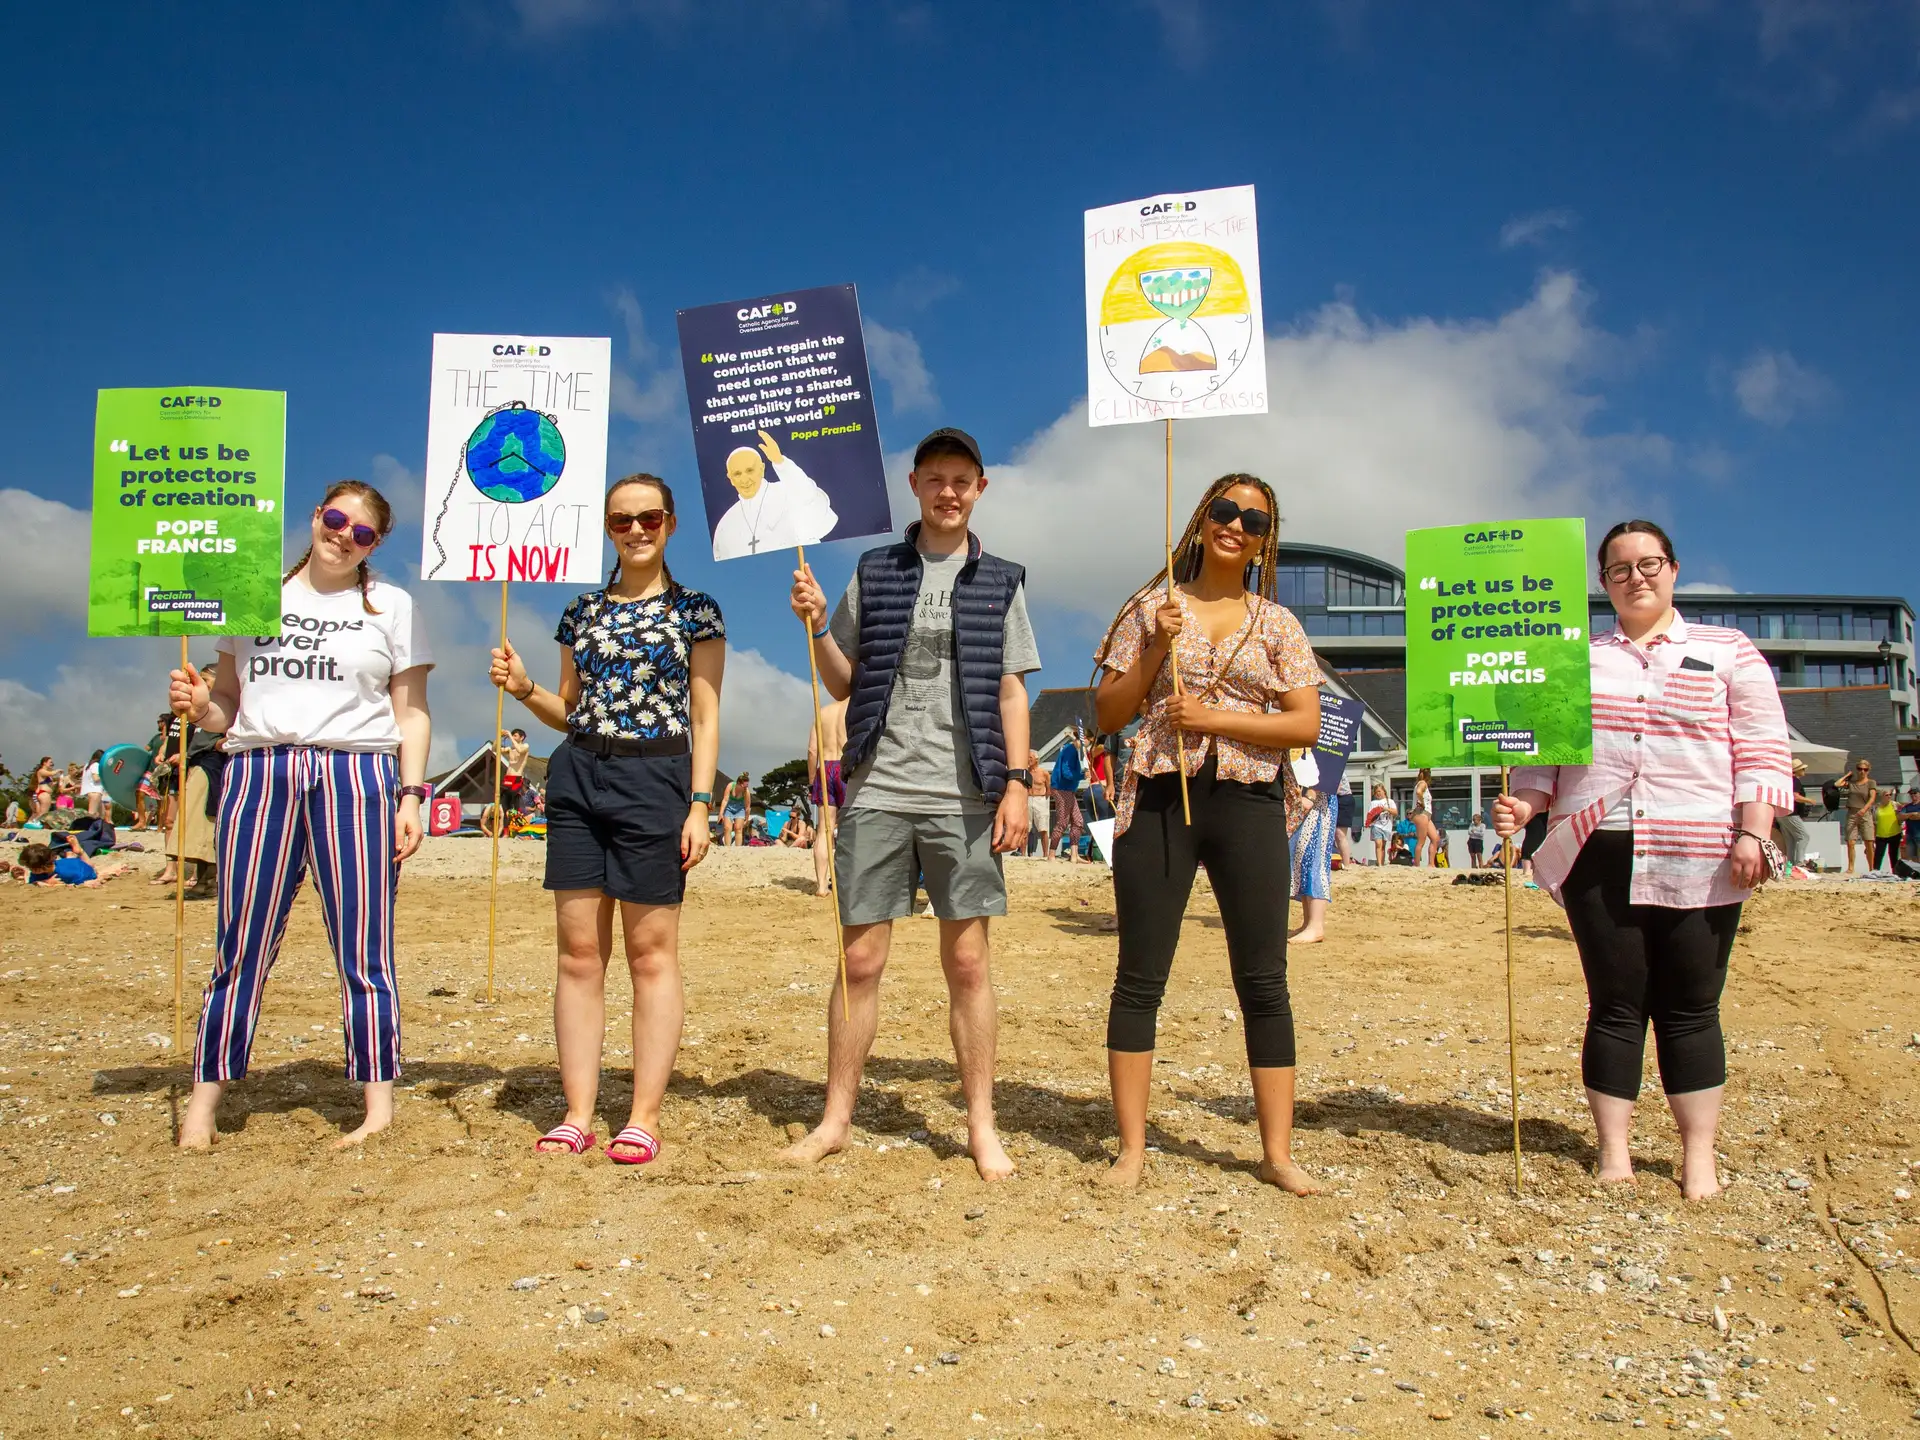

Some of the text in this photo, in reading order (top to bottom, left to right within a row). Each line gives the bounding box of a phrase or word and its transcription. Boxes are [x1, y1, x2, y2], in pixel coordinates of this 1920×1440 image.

[1088, 216, 1248, 249] TURN BACK THE
[740, 346, 774, 360] must
[777, 339, 819, 355] regain
[821, 335, 845, 347] the
[713, 351, 837, 378] conviction that we
[1106, 351, 1117, 367] 8
[1228, 349, 1240, 366] 4
[717, 365, 838, 393] need one another,
[1133, 381, 1143, 394] 7
[1207, 375, 1220, 392] 5
[446, 369, 593, 411] THE TIME
[706, 375, 852, 409] that we have a shared
[1170, 380, 1183, 398] 6
[702, 390, 861, 424] responsibility for others
[1094, 392, 1265, 421] CLIMATE CRISIS
[731, 421, 757, 434] and
[758, 416, 782, 429] the
[791, 422, 862, 441] Pope Francis
[179, 445, 208, 461] us
[218, 443, 250, 461] be
[120, 467, 257, 488] protectors
[119, 490, 146, 507] of
[156, 520, 218, 536] POPE
[468, 502, 589, 549] TO ACT
[137, 539, 237, 554] FRANCIS
[465, 544, 570, 582] IS NOW!
[1485, 578, 1514, 593] us
[1523, 575, 1554, 592] be
[152, 591, 192, 600] reclaim
[171, 601, 219, 609] common
[919, 608, 948, 619] & Save
[1431, 599, 1561, 623] protectors
[187, 610, 219, 619] home
[1431, 623, 1456, 641] of
[1466, 651, 1527, 667] POPE
[249, 655, 344, 682] profit.
[1449, 668, 1546, 686] FRANCIS
[1465, 721, 1505, 731] reclaim
[1465, 731, 1531, 741] our common
[1501, 740, 1531, 750] home
